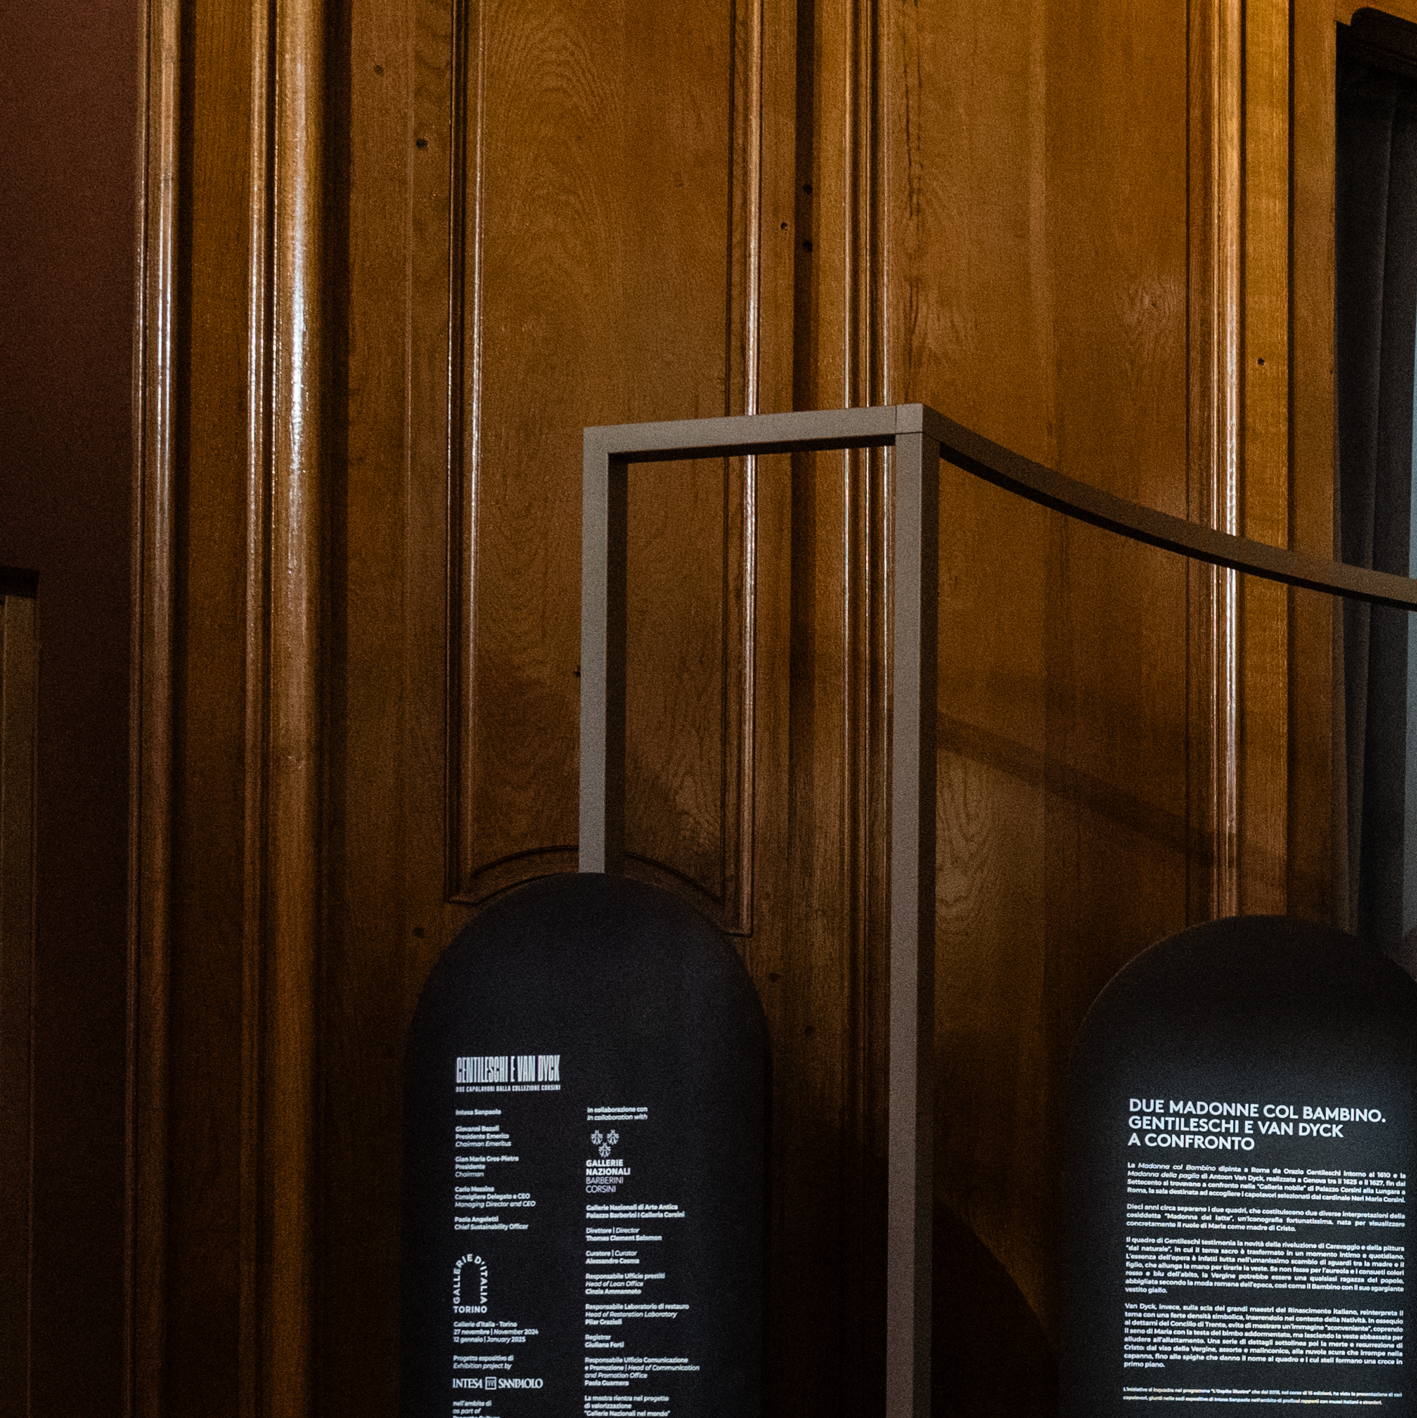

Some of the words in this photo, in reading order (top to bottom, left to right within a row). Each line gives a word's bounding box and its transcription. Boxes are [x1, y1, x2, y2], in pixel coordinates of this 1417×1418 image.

[456, 1055, 508, 1083] GENTILESCHI
[510, 1055, 515, 1082] E
[517, 1054, 535, 1082] VAN
[537, 1054, 560, 1082] DYCK
[1129, 1098, 1164, 1113] DUE
[1169, 1099, 1259, 1117] MADONNE
[1263, 1103, 1299, 1119] COL
[1302, 1105, 1386, 1122] BAMBINO.
[1128, 1115, 1239, 1133] GENTILESCHI
[1244, 1119, 1253, 1133] E
[1257, 1120, 1293, 1135] VAN
[1298, 1122, 1344, 1137] DYCK
[1127, 1132, 1141, 1146] A
[1144, 1132, 1255, 1150] CONFRONTO
[585, 1158, 623, 1167] GALLERIE
[585, 1167, 630, 1175] NAZIONALI
[585, 1175, 623, 1184] BARBERINI
[585, 1184, 616, 1193] CORSINI
[1176, 1205, 1207, 1213] separano
[1224, 1206, 1248, 1214] quadri,
[1261, 1207, 1304, 1215] costituiscono
[1318, 1209, 1341, 1217] diverse
[1341, 1210, 1388, 1219] interpretazioni
[1126, 1211, 1161, 1219] cosiddetta
[1285, 1216, 1333, 1225] fortunatissima,
[1368, 1219, 1405, 1227] visualizzare
[1246, 1223, 1268, 1231] madre
[453, 1253, 473, 1304] GALLERIE
[474, 1255, 488, 1304] D'ITALIA
[452, 1305, 487, 1313] TORINO
[1139, 1302, 1157, 1310] Dyck,
[1226, 1305, 1248, 1313] grandi
[1287, 1306, 1332, 1314] Rinascimento
[1332, 1307, 1358, 1315] italiano,
[486, 1335, 511, 1343] January
[482, 1362, 503, 1370] project
[503, 1362, 512, 1370] by
[452, 1377, 482, 1388] INTESA
[498, 1377, 543, 1388] SANPAOLO
